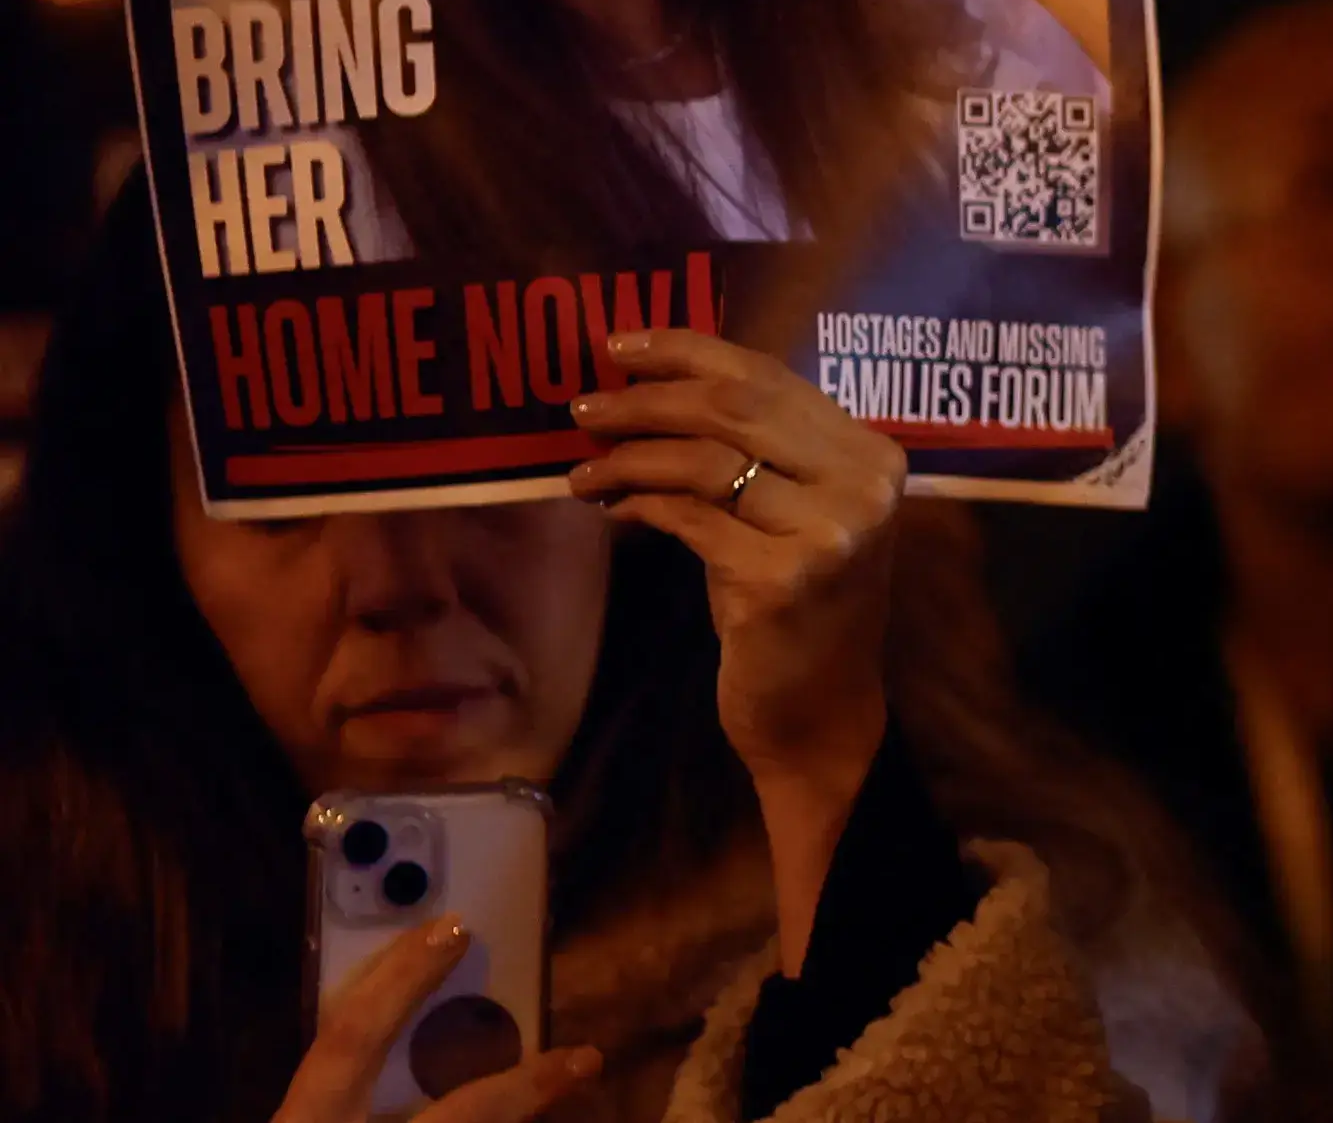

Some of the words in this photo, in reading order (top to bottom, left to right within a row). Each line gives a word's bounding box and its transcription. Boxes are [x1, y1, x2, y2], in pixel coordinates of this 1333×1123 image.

[188, 139, 354, 280] HER
[208, 288, 444, 432] HOME
[817, 311, 941, 360] HOSTAGES
[945, 318, 995, 362] AND
[998, 321, 1108, 369] MISSING
[819, 356, 974, 426] FAMILIES
[980, 364, 1109, 433] FORUM
